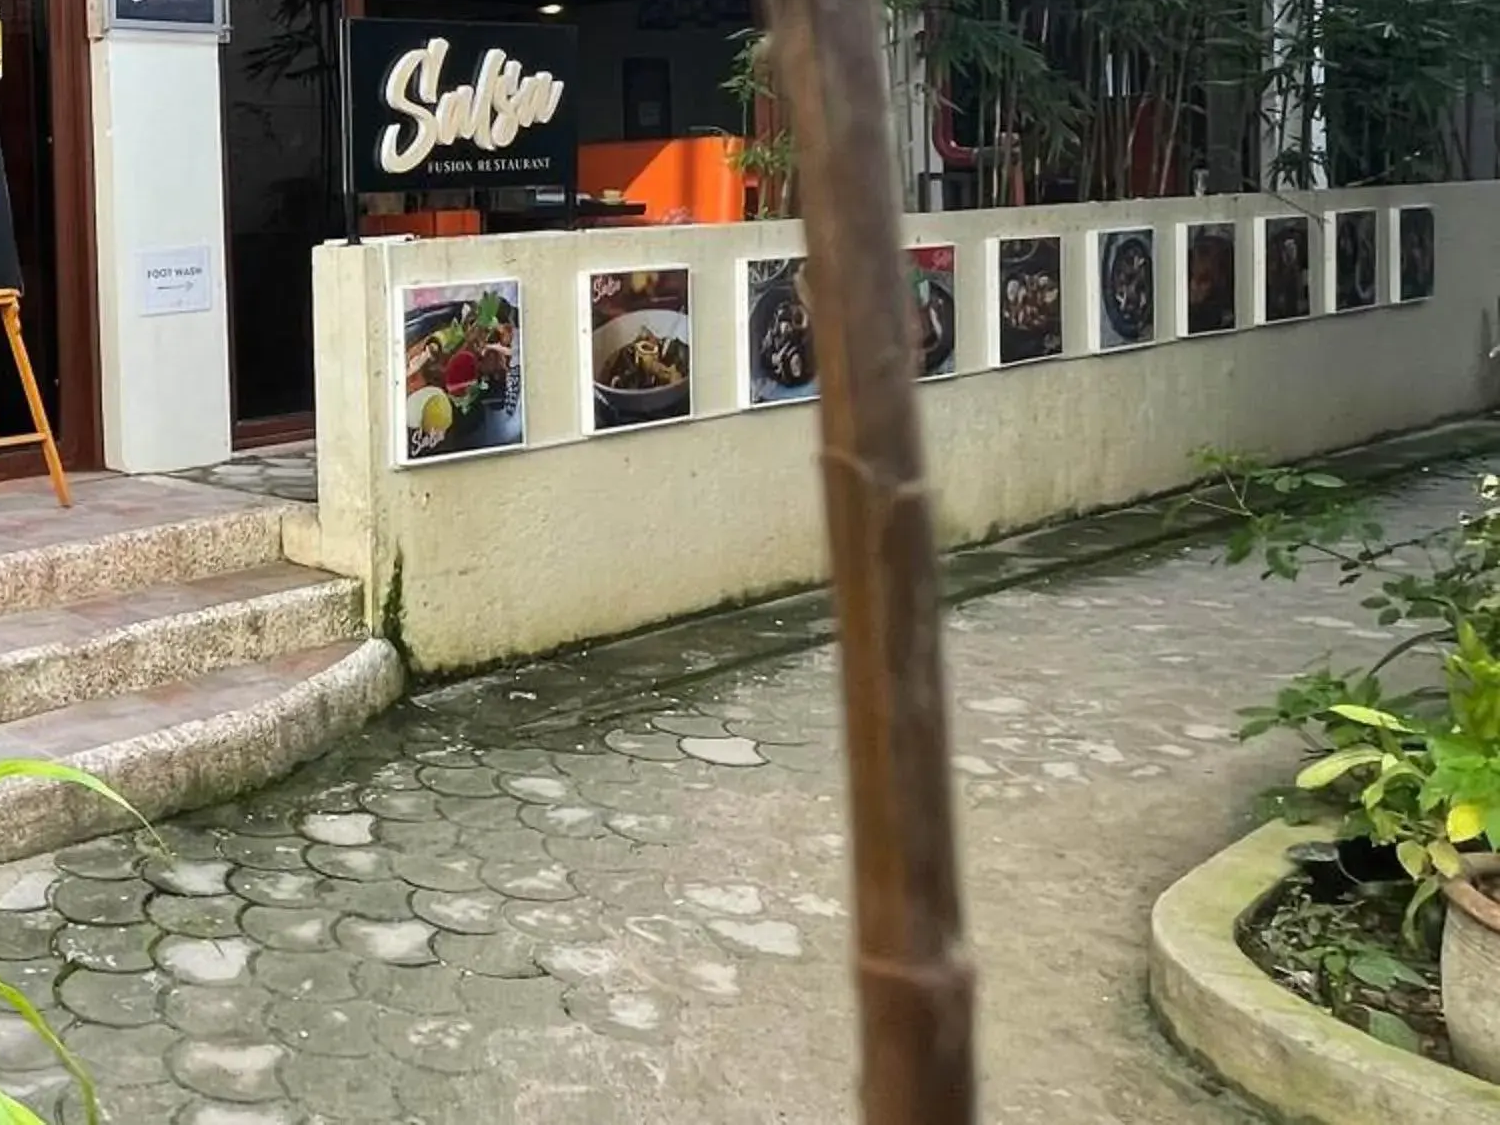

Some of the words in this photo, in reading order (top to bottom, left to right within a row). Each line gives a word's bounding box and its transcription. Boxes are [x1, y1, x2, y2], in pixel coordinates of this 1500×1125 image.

[380, 37, 564, 173] Salsa
[427, 160, 473, 174] FUSION
[477, 157, 551, 172] RESTAURANT
